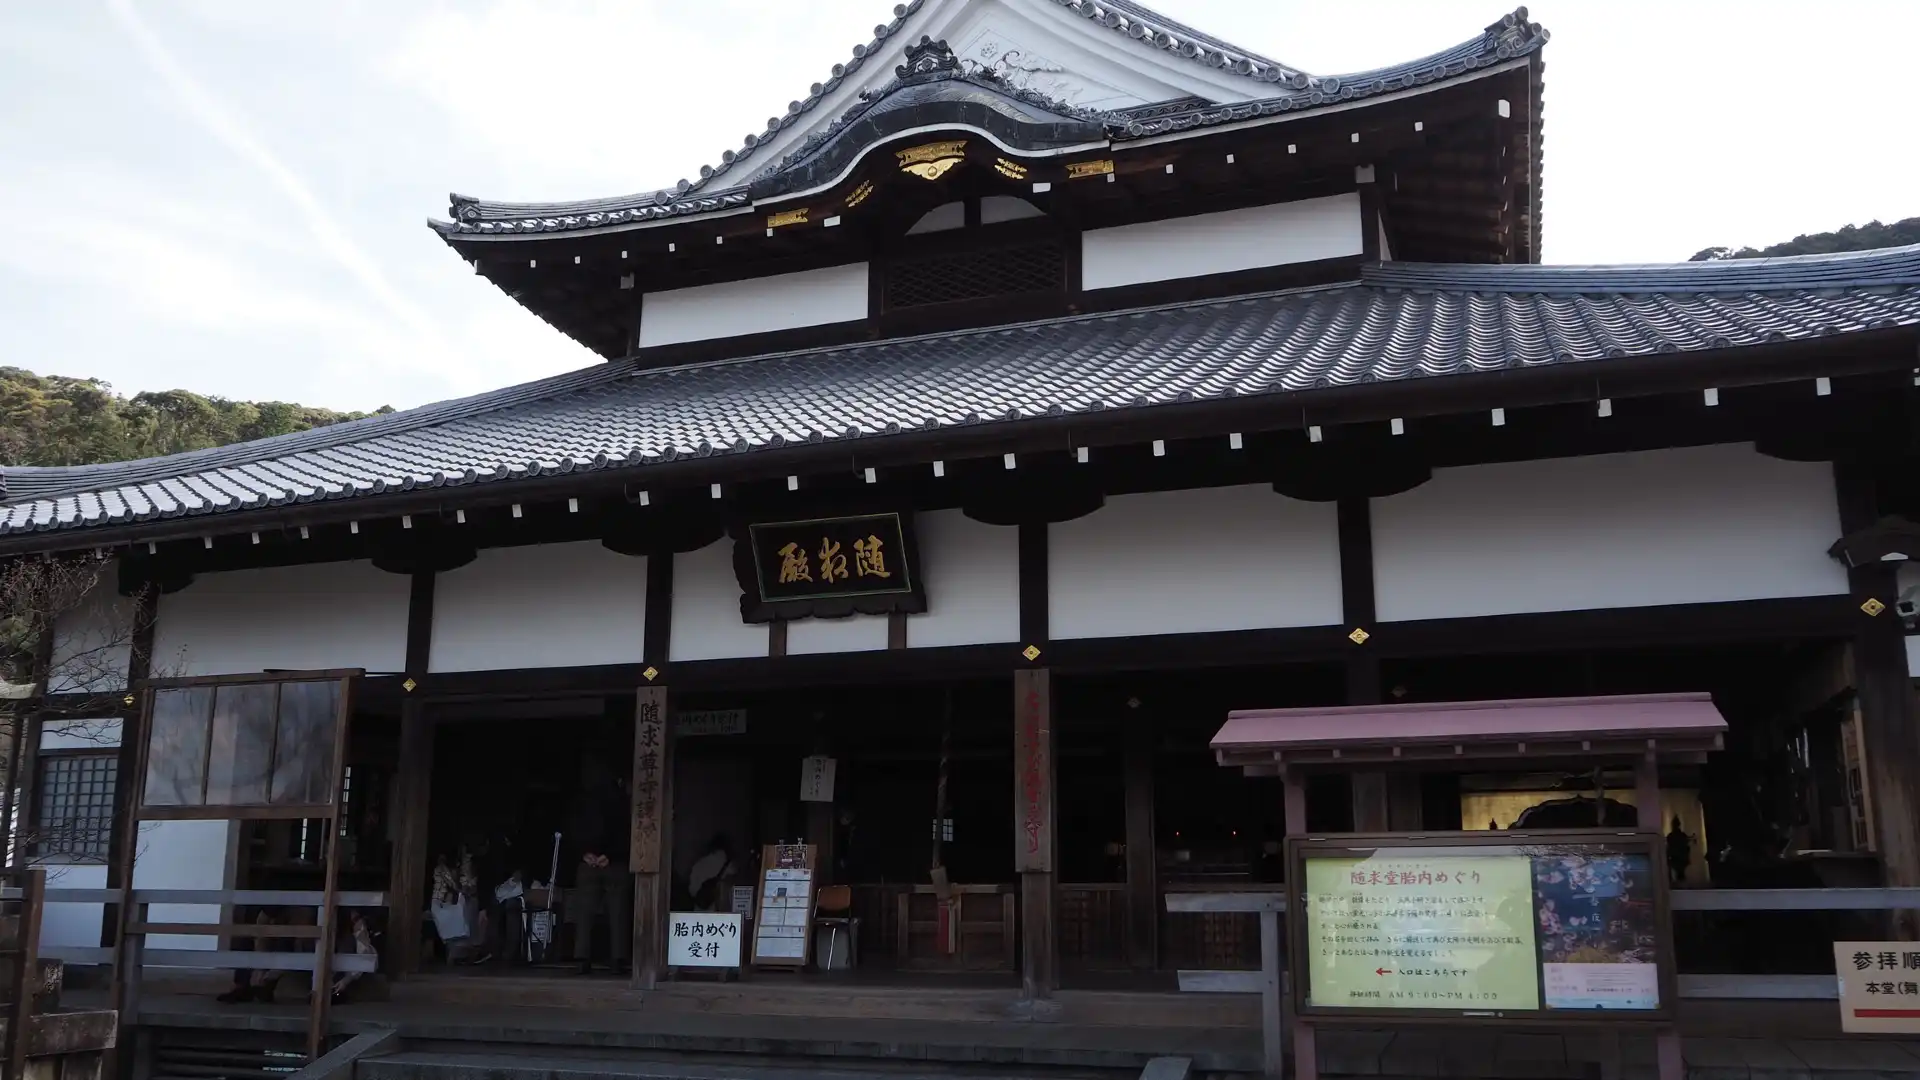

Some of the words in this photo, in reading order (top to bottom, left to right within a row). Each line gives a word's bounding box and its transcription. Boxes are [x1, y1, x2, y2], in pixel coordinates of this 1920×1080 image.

[1350, 870, 1481, 886] 随求堂胎内めぐり
[673, 922, 737, 938] 胎内めぐり
[688, 941, 721, 958] 受付
[1852, 951, 1920, 971] 参拝順
[1398, 967, 1468, 977] 入口はこちらです
